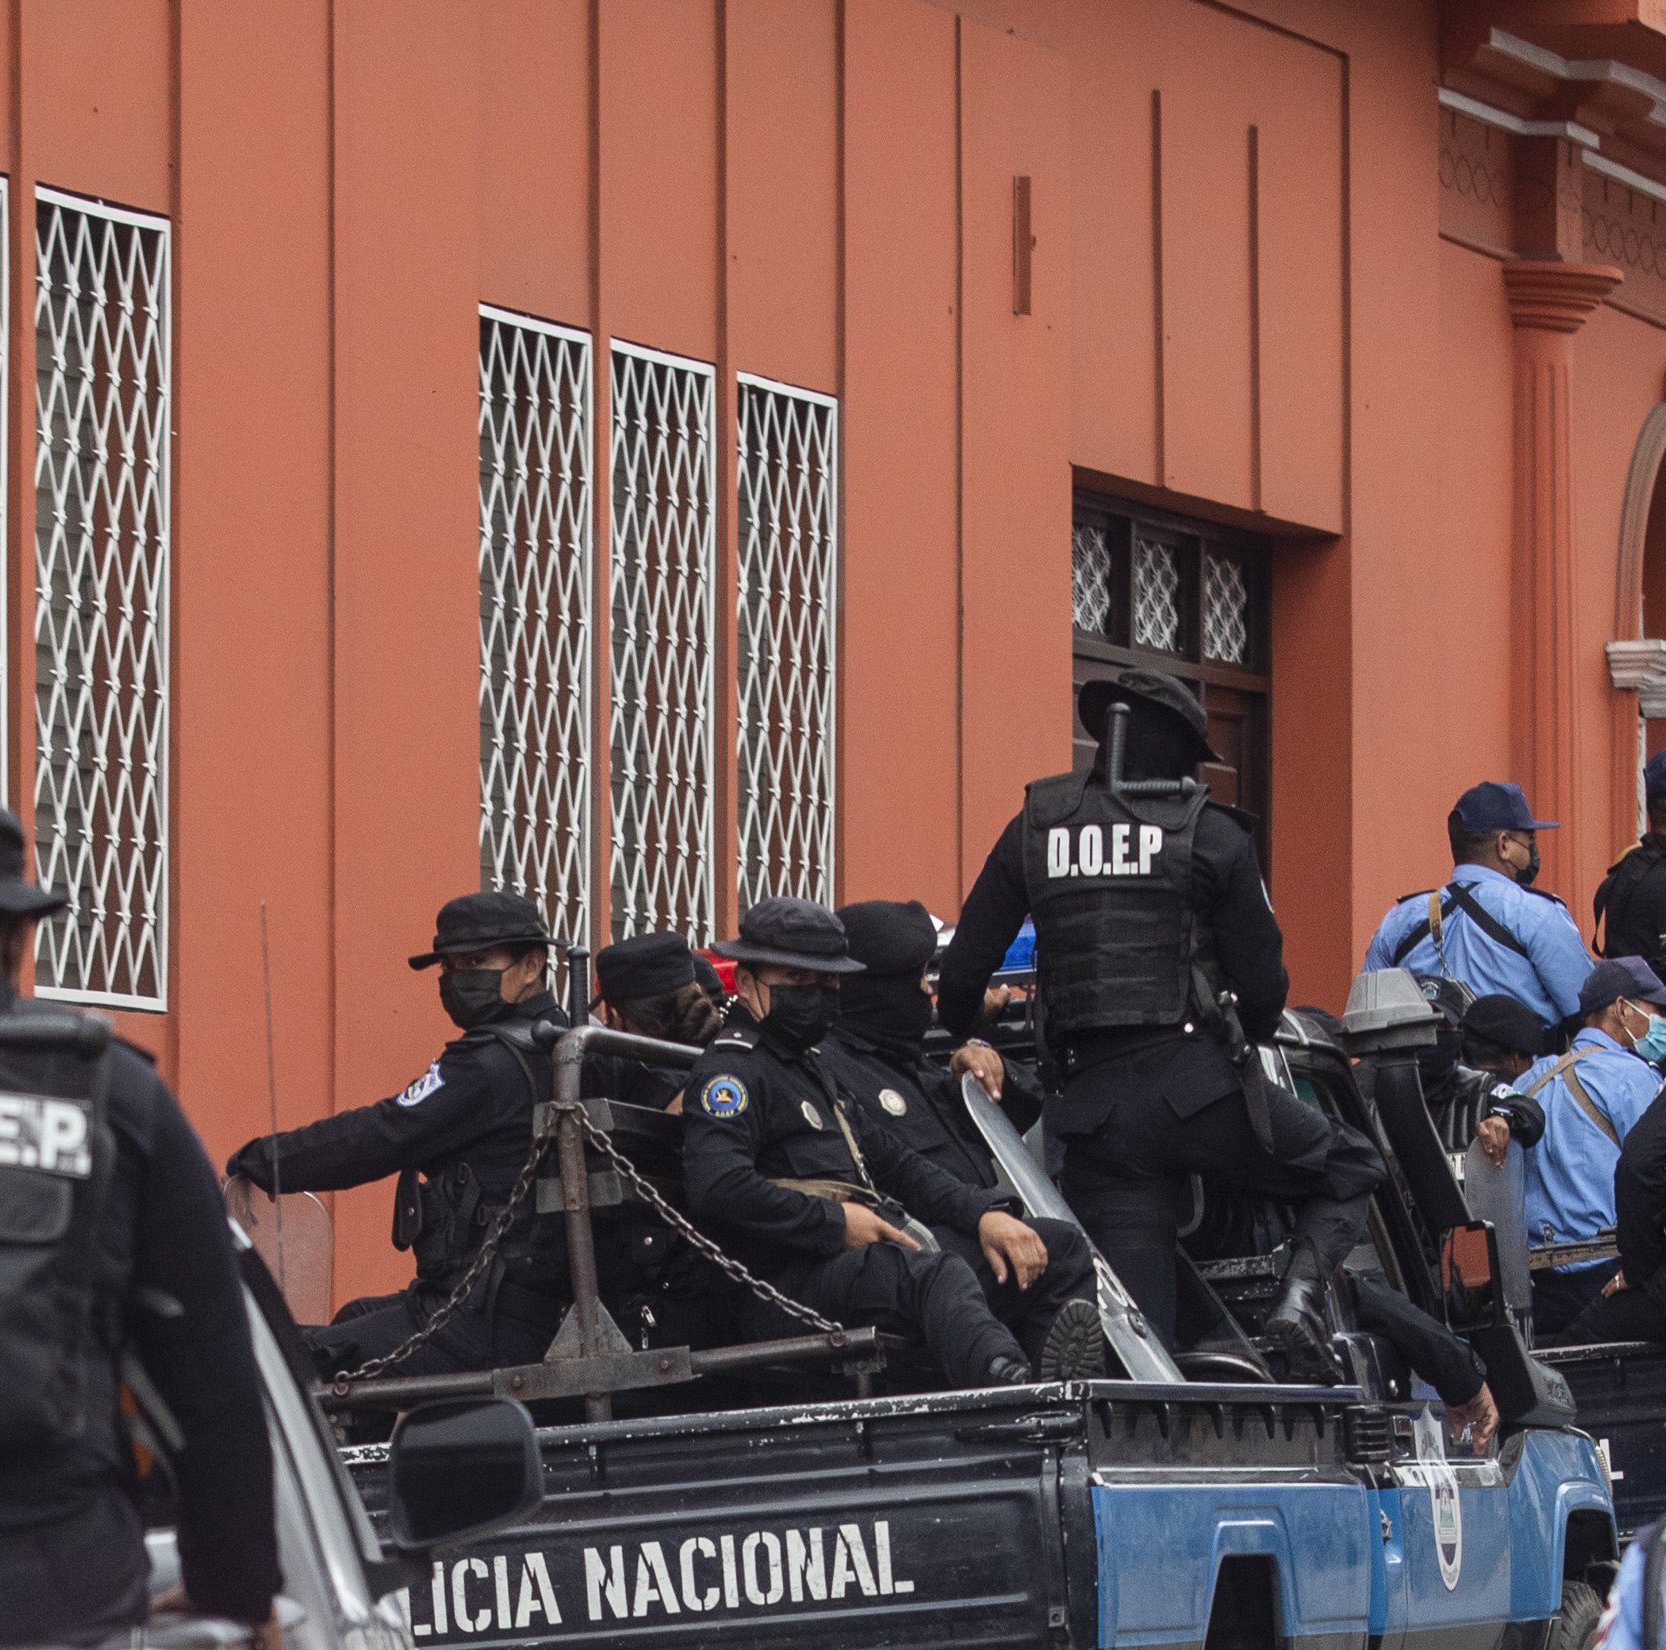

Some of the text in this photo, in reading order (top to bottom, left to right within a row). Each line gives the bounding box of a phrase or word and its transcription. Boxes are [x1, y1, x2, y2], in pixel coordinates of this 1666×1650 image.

[1047, 823, 1163, 878] D.O.E.P
[396, 1520, 915, 1636] LICIA NACIONAL
